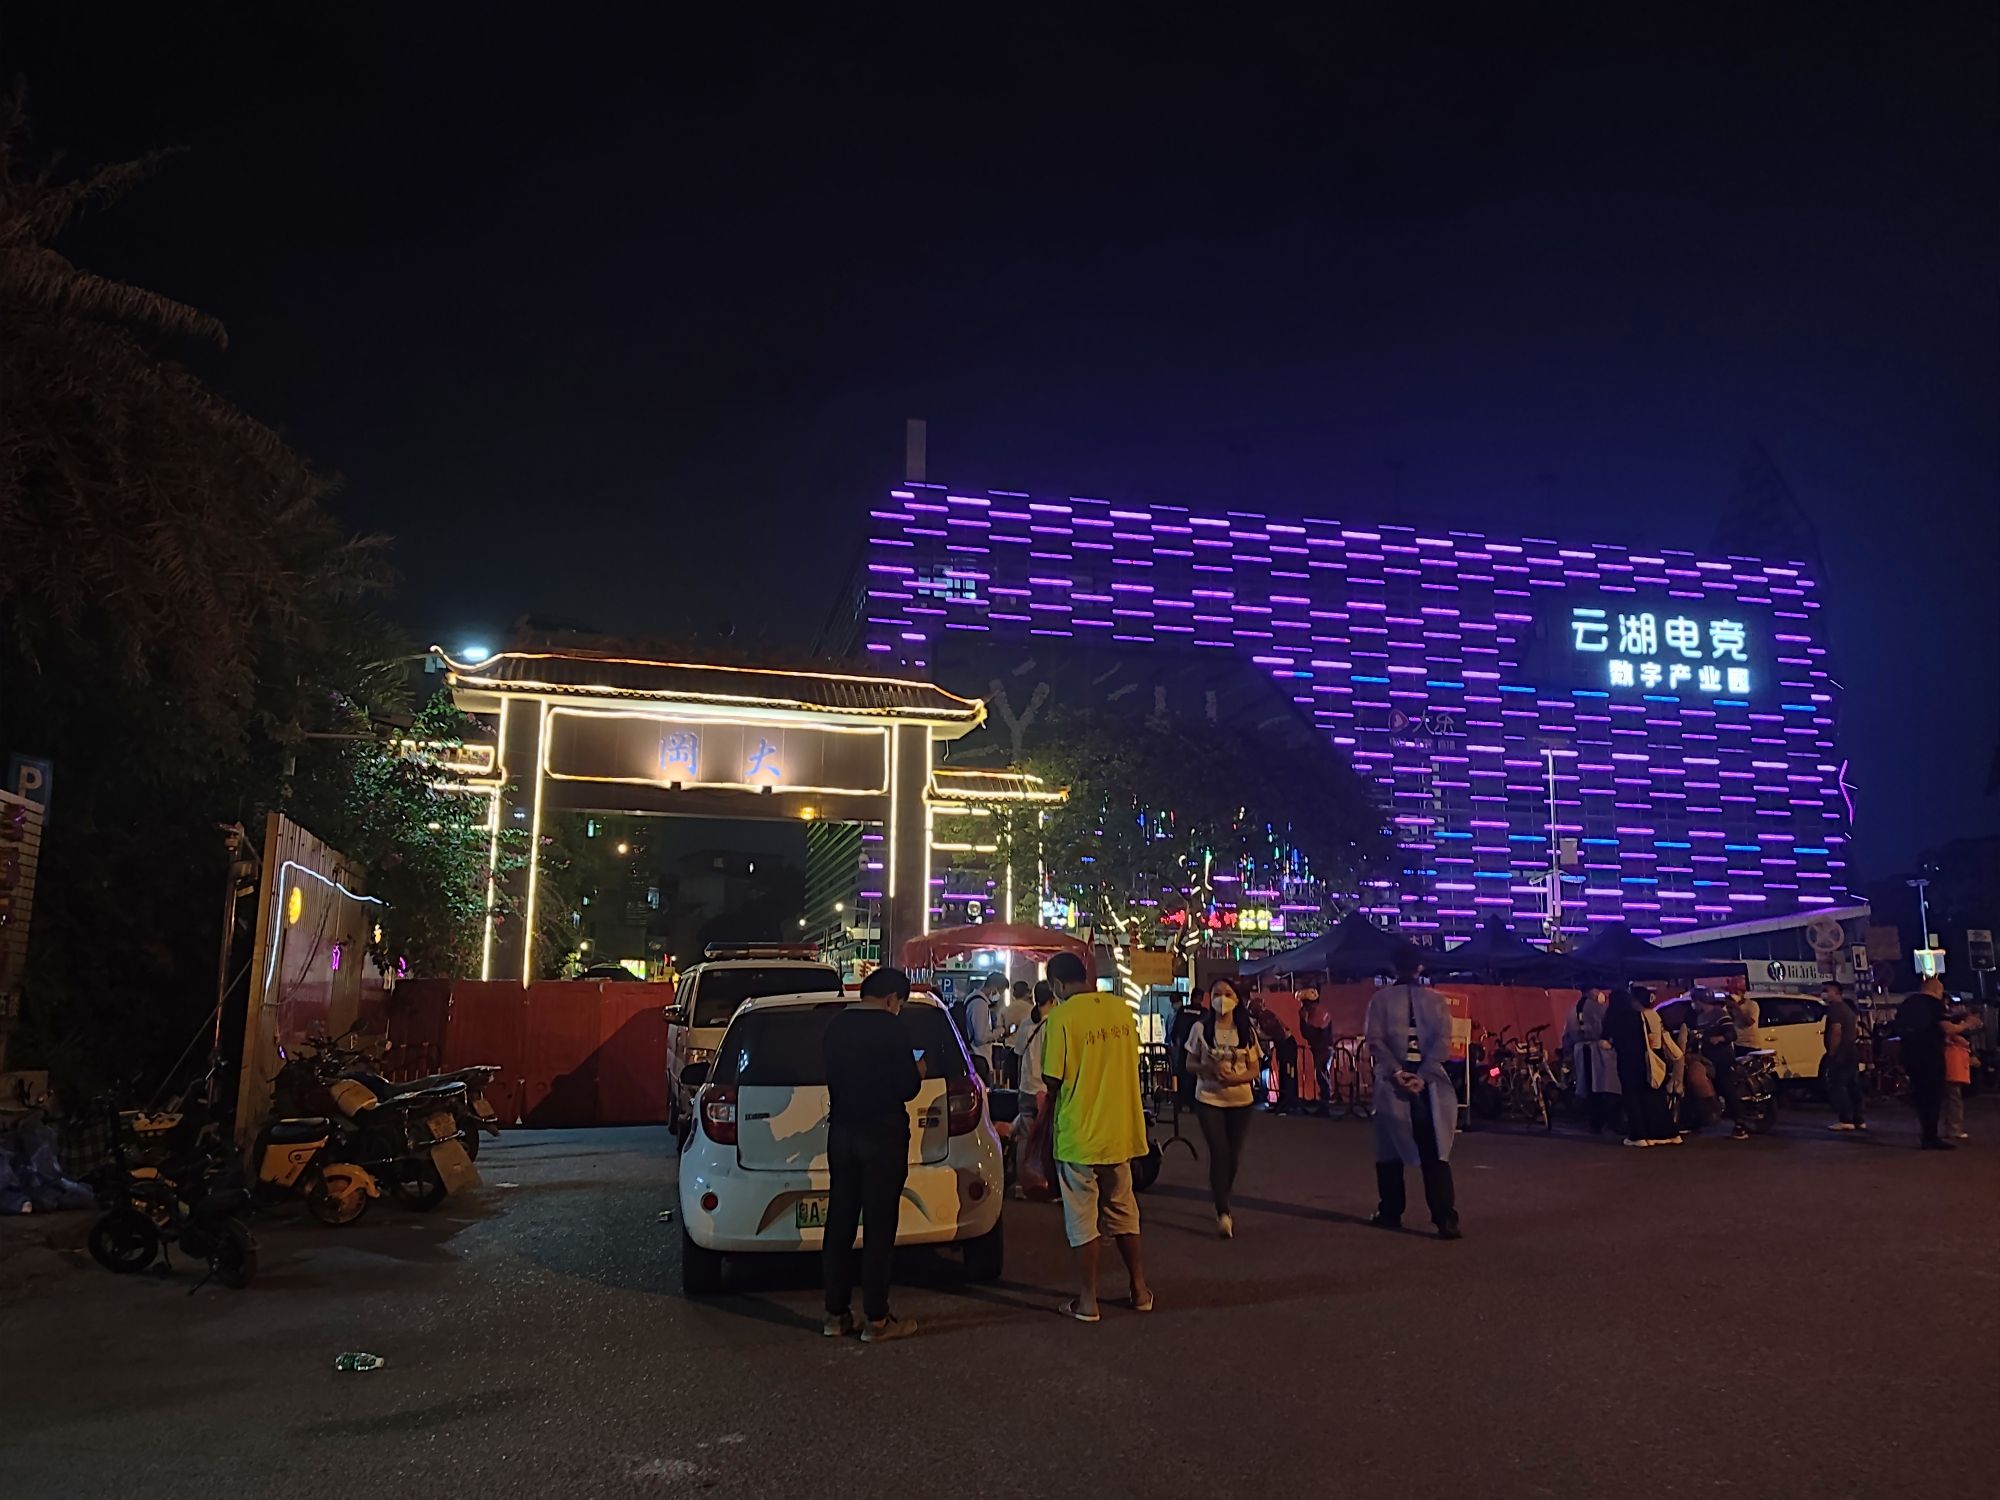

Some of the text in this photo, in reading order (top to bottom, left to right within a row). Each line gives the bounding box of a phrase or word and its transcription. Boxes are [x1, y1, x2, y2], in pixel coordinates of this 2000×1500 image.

[1571, 607, 1749, 661] 云湖电竞
[1608, 659, 1750, 693] 数字产业园
